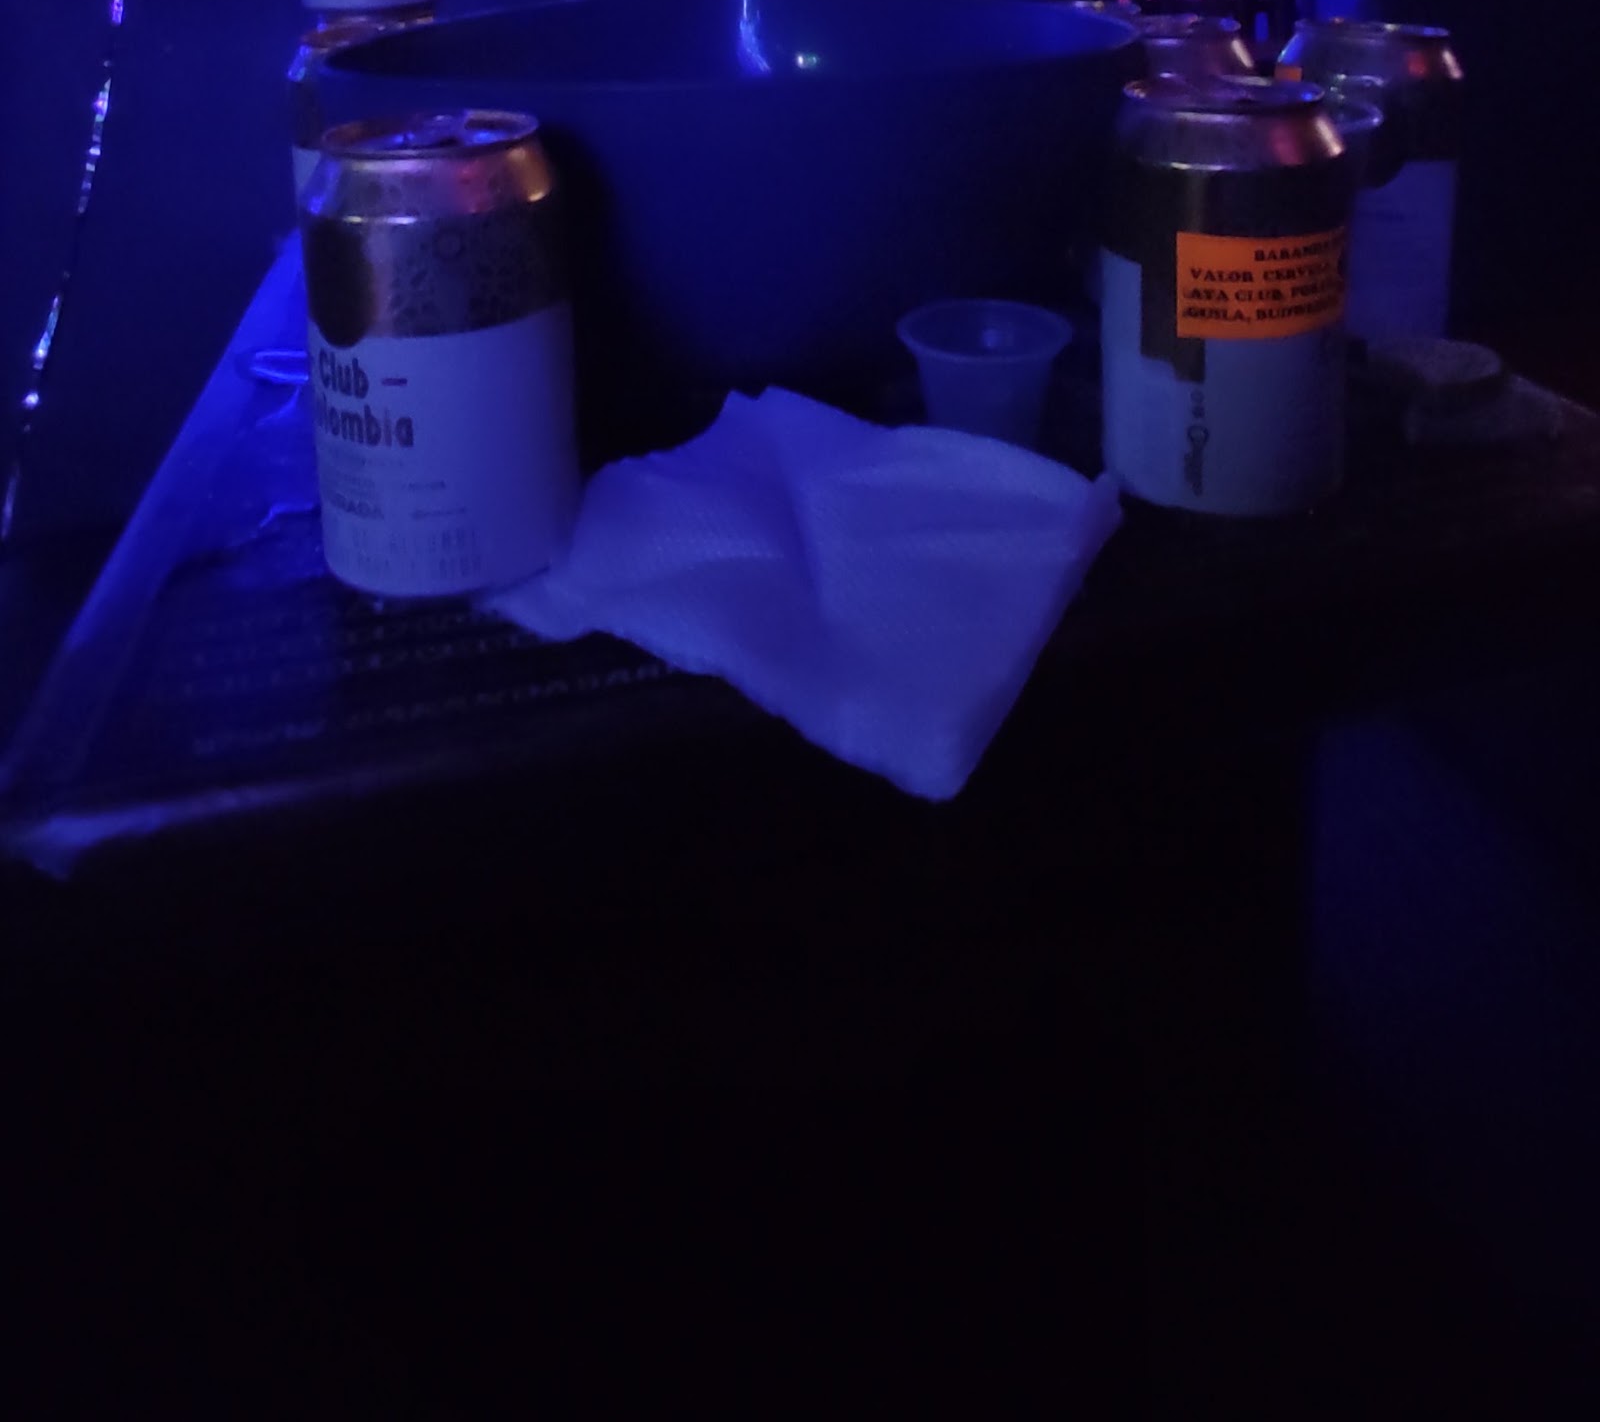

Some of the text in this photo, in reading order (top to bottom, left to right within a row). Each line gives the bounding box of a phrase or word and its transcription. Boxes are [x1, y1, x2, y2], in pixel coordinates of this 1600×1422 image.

[1190, 266, 1254, 283] VALOR
[318, 349, 369, 399] Club
[316, 393, 414, 447] olombia
